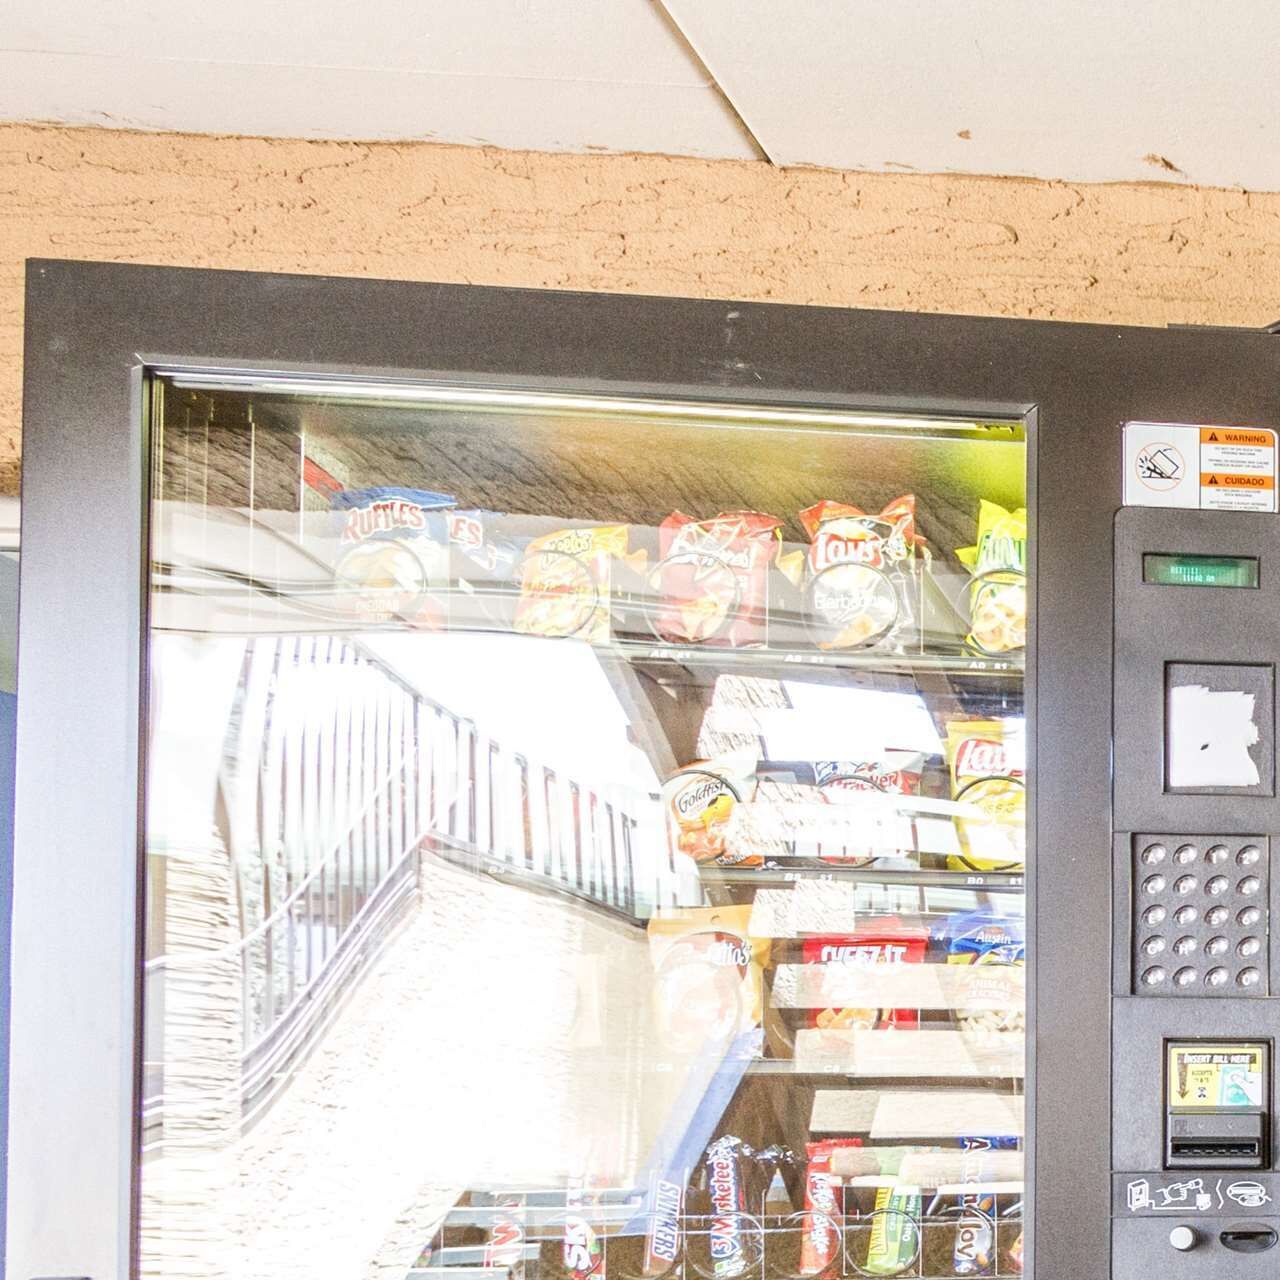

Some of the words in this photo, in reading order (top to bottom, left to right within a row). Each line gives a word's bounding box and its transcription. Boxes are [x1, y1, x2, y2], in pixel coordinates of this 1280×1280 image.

[1224, 433, 1267, 443] WARNING
[1224, 476, 1265, 486] CUIDADO
[342, 501, 425, 545] RUFFLES
[975, 930, 1012, 945] Austin
